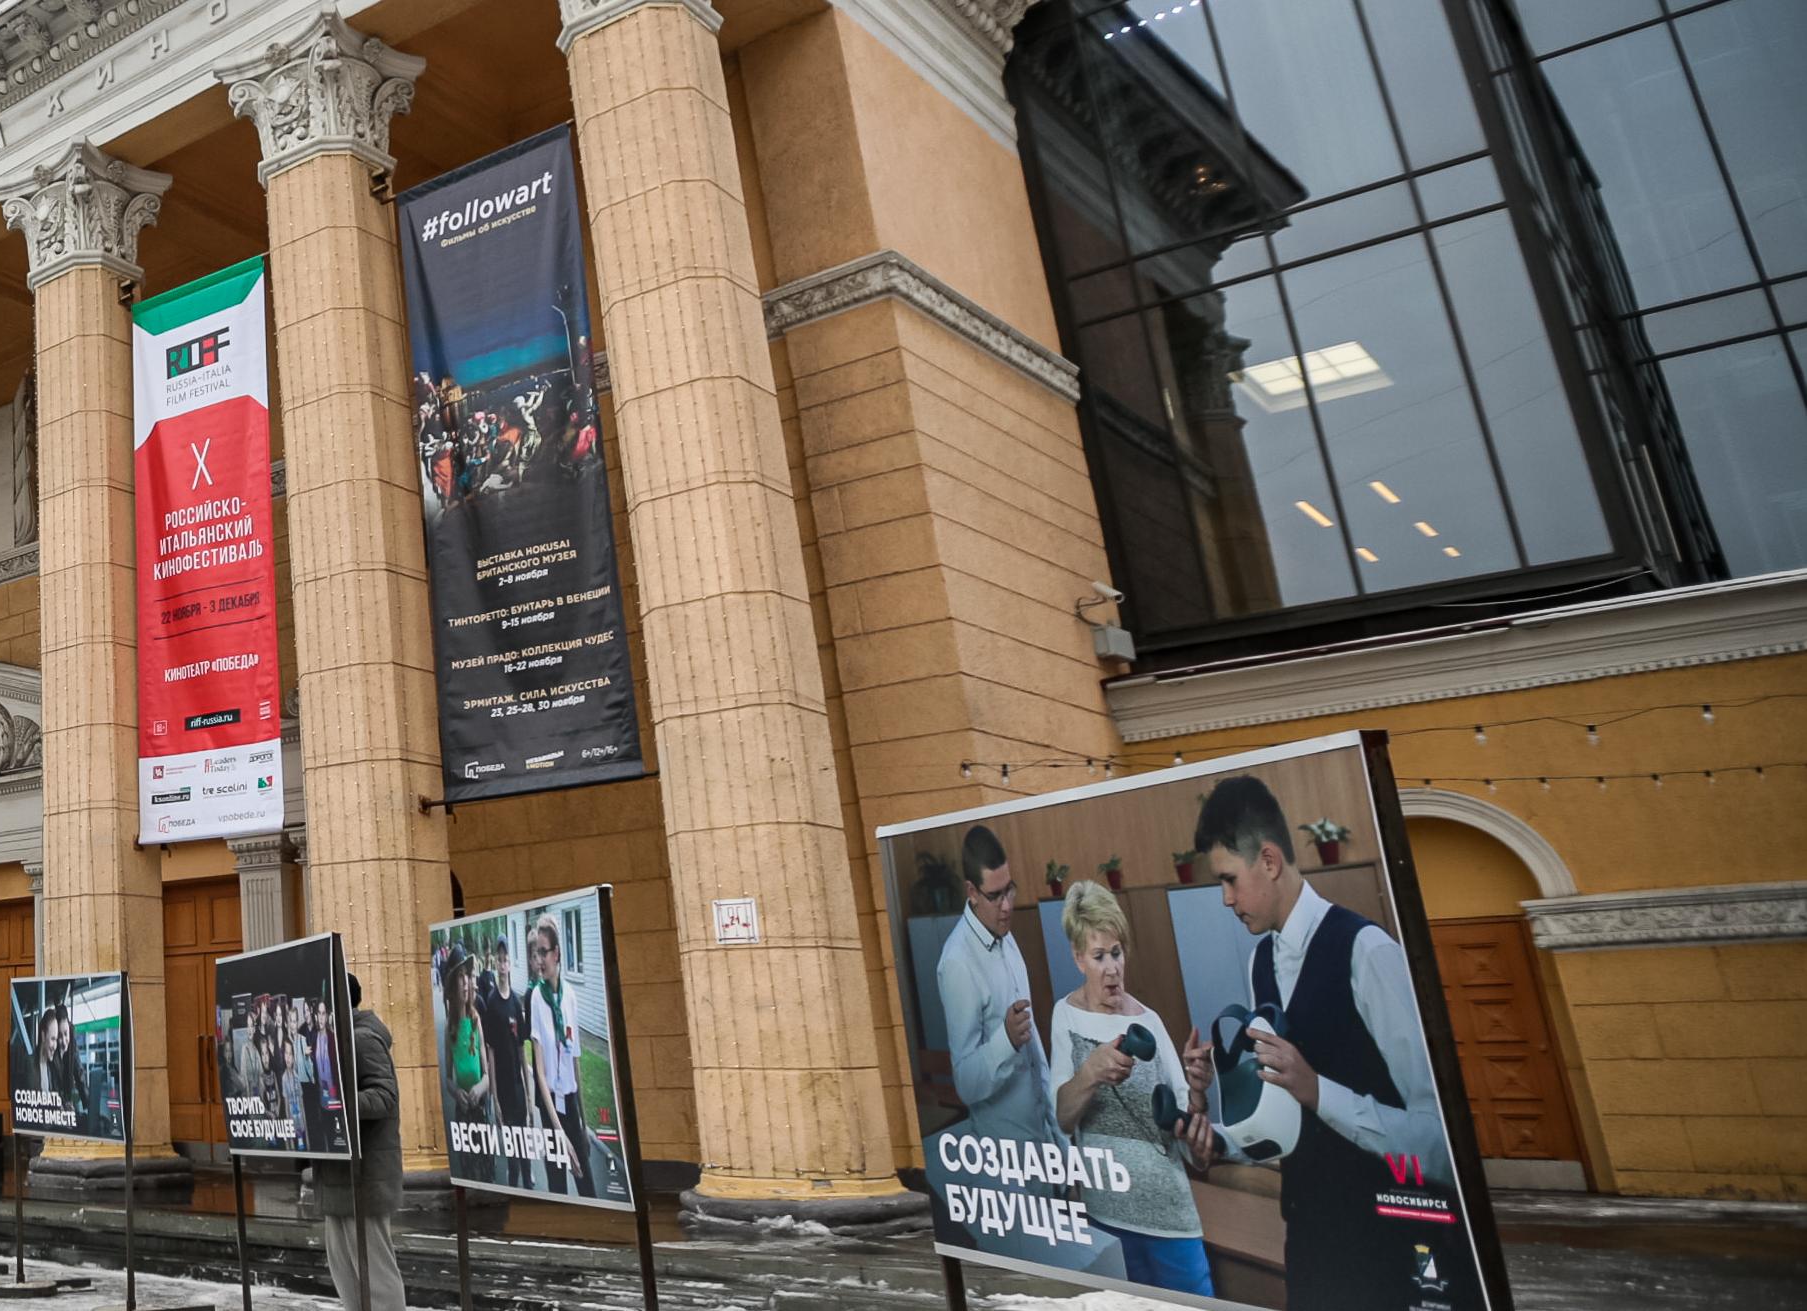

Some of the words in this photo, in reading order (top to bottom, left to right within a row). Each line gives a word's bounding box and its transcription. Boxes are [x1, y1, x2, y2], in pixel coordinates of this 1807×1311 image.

[422, 171, 553, 243] #followart
[441, 228, 476, 248] Фильмы
[478, 222, 490, 234] об
[491, 204, 537, 229] искусстве
[166, 391, 187, 407] FILM
[189, 378, 230, 398] FESTIVAL
[190, 438, 213, 490] X
[165, 496, 247, 531] РОССИЙСКО-
[159, 515, 253, 556] ИТАЛЬЯНСКИЙ
[153, 541, 263, 581] КИНОФЕСТИВАЛЬ
[476, 557, 540, 581] БРИТАНСКОГО
[542, 550, 577, 565] МУЗЕЯ
[477, 548, 524, 568] ВЫСТАВКА
[525, 539, 571, 556] HOKUSAI
[515, 568, 548, 585] ноября
[161, 611, 171, 625] 22
[172, 602, 202, 623] НОЯБРЯ
[210, 601, 216, 614] 3
[218, 590, 260, 613] ДЕКАБРЯ
[448, 608, 509, 628] ТИНТОРЕТТО:
[511, 598, 554, 616] БУНТАРЬ
[557, 595, 564, 606] В
[566, 585, 611, 604] ВЕНЕЦИИ
[520, 611, 555, 628] ноября
[451, 654, 485, 670] МУЗЕЙ
[486, 650, 520, 665] ПРАДО:
[521, 638, 582, 658] КОЛЛЕКЦИЯ
[584, 630, 614, 647] ЧУДЕС
[528, 655, 562, 671] ноября
[164, 660, 210, 683] КИНОТЕАТР
[211, 652, 259, 673] «ПОБЕДА»
[463, 694, 517, 710] ЭРМИТАЖ.
[519, 688, 547, 702] СИЛА
[549, 677, 611, 696] ИСКУССТВА
[490, 707, 504, 718] 23,
[537, 700, 550, 711] 30
[551, 693, 585, 710] ноября
[190, 713, 233, 729] riff-russia.ru
[476, 763, 505, 773] ПОБЕДА
[168, 818, 196, 828] ПОБЕДА
[15, 1089, 62, 1107] СОЗДАВАТЬ
[226, 1096, 265, 1116] ТВОРИТЬ
[15, 1108, 43, 1123] НОВОЕ
[44, 1110, 77, 1127] ВМЕСТЕ
[230, 1120, 253, 1138] СВОЕ
[254, 1119, 296, 1141] БУДУЩЕЕ
[450, 1120, 501, 1156] ВЕСТИ
[501, 1124, 572, 1170] ВПЕРЕД
[938, 1132, 1131, 1193] СОЗДАВАТЬ
[1384, 1152, 1425, 1186] VI
[946, 1183, 1093, 1246] БУДУЩЕЕ
[1376, 1193, 1448, 1209] НОВОСИБИРСК
